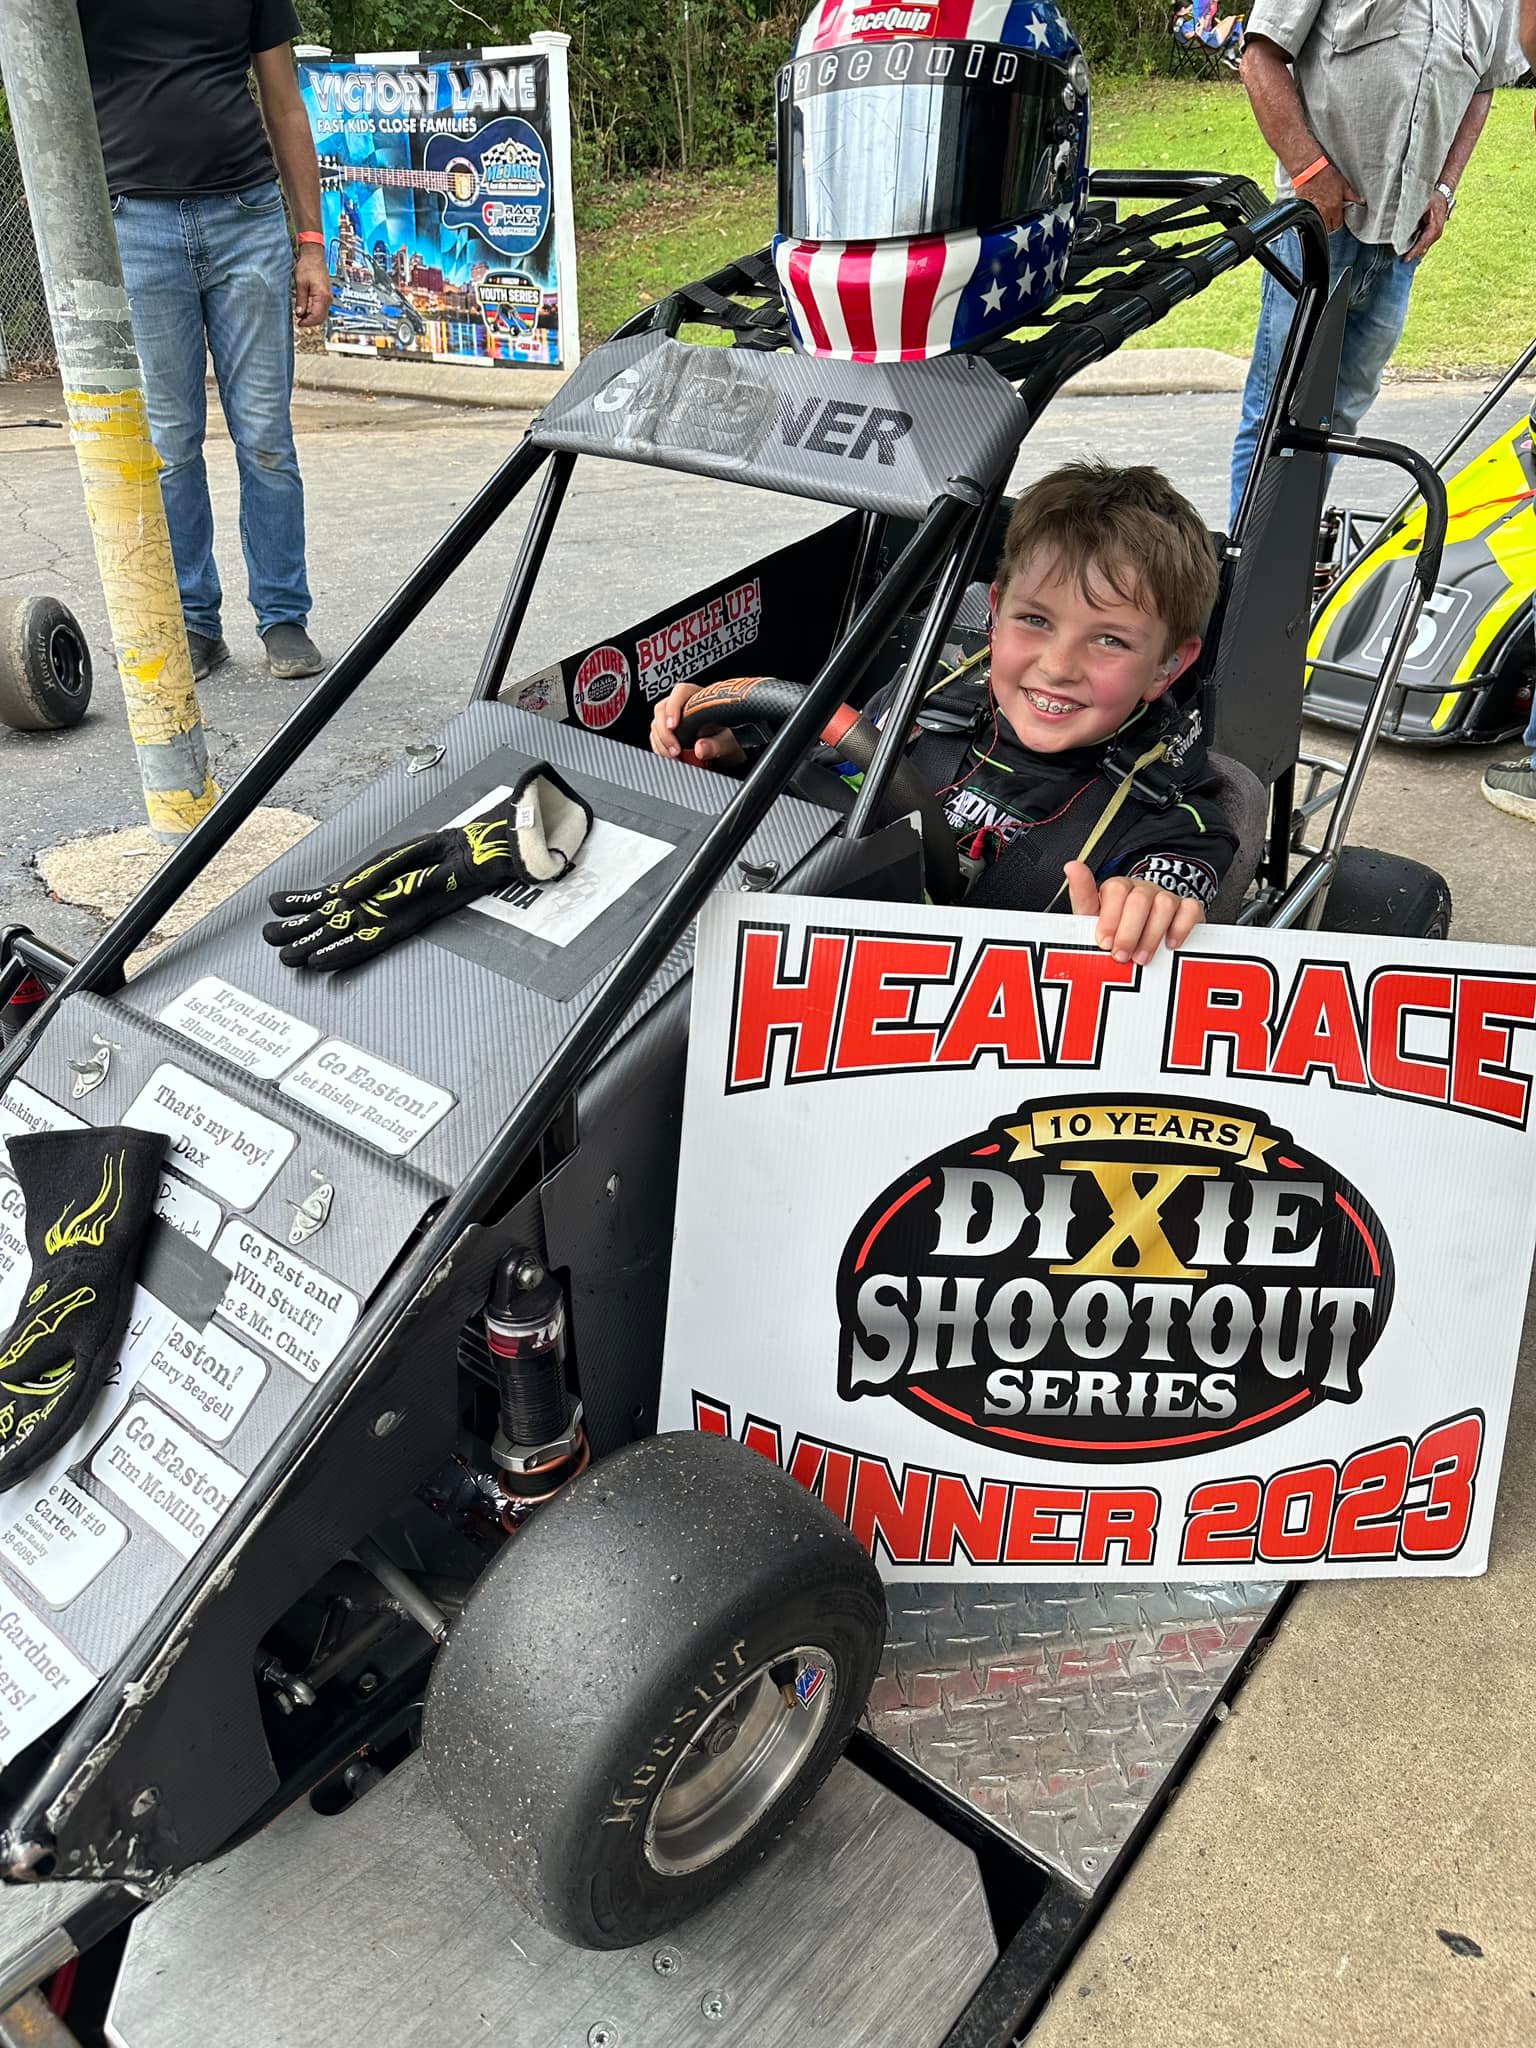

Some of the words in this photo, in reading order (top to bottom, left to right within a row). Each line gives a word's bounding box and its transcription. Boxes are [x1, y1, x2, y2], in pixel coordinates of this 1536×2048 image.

[309, 71, 440, 114] VICTORY
[449, 65, 537, 111] LANE
[317, 118, 344, 133] FAST
[350, 118, 376, 133] KIDS
[379, 118, 416, 133] CLOSE
[419, 117, 477, 133] FAMILIES
[505, 205, 541, 215] RACE
[480, 288, 507, 301] YOUTH
[508, 290, 539, 304] SERIES
[638, 598, 723, 672] BUCKLE
[726, 578, 760, 620] UP!
[640, 671, 649, 688] I
[653, 632, 722, 678] WANNA
[726, 609, 760, 637] TRY
[578, 648, 624, 692] FEATURE
[647, 626, 758, 699] SOMETHING
[581, 683, 627, 728] WINNER
[221, 998, 255, 1017] you
[251, 1012, 291, 1036] Ain't
[245, 1030, 291, 1058] Last!
[724, 920, 1143, 1096] HEAT
[1160, 951, 1536, 1132] RACE
[213, 1036, 261, 1067] Family
[0, 1092, 42, 1132] Making
[293, 1071, 319, 1089] Jet
[316, 1082, 363, 1114] Risley
[360, 1105, 418, 1144] Racing
[317, 1052, 347, 1075] Go
[344, 1065, 439, 1119] Easton!
[154, 1084, 205, 1126] That's
[203, 1119, 234, 1146] my
[232, 1131, 276, 1166] boy!
[172, 1134, 210, 1168] Dax
[1049, 1114, 1093, 1139] 10
[1107, 1110, 1242, 1147] YEARS
[1, 1189, 26, 1219] Go
[929, 1160, 1324, 1278] DIXIE
[233, 1262, 266, 1298] Win
[266, 1288, 324, 1336] Stuff!
[239, 1233, 262, 1259] Go
[262, 1248, 304, 1288] Fast
[305, 1278, 343, 1313] and
[168, 1322, 244, 1391] aston!
[235, 1302, 248, 1321] &
[247, 1309, 273, 1340] Mr.
[275, 1331, 321, 1373] Chris
[851, 1273, 1376, 1393] SHOOTOUT
[151, 1351, 183, 1384] Gary
[181, 1380, 235, 1422] Beagell
[983, 1368, 1238, 1419] SERIES
[125, 1416, 155, 1451] Go
[58, 1488, 88, 1519] WIN
[80, 1511, 107, 1537] #10
[107, 1445, 141, 1484] Tim
[138, 1477, 210, 1541] McMillo
[1178, 1407, 1486, 1566] 2023
[34, 1499, 77, 1542] Carter
[0, 1611, 71, 1690] Gardner
